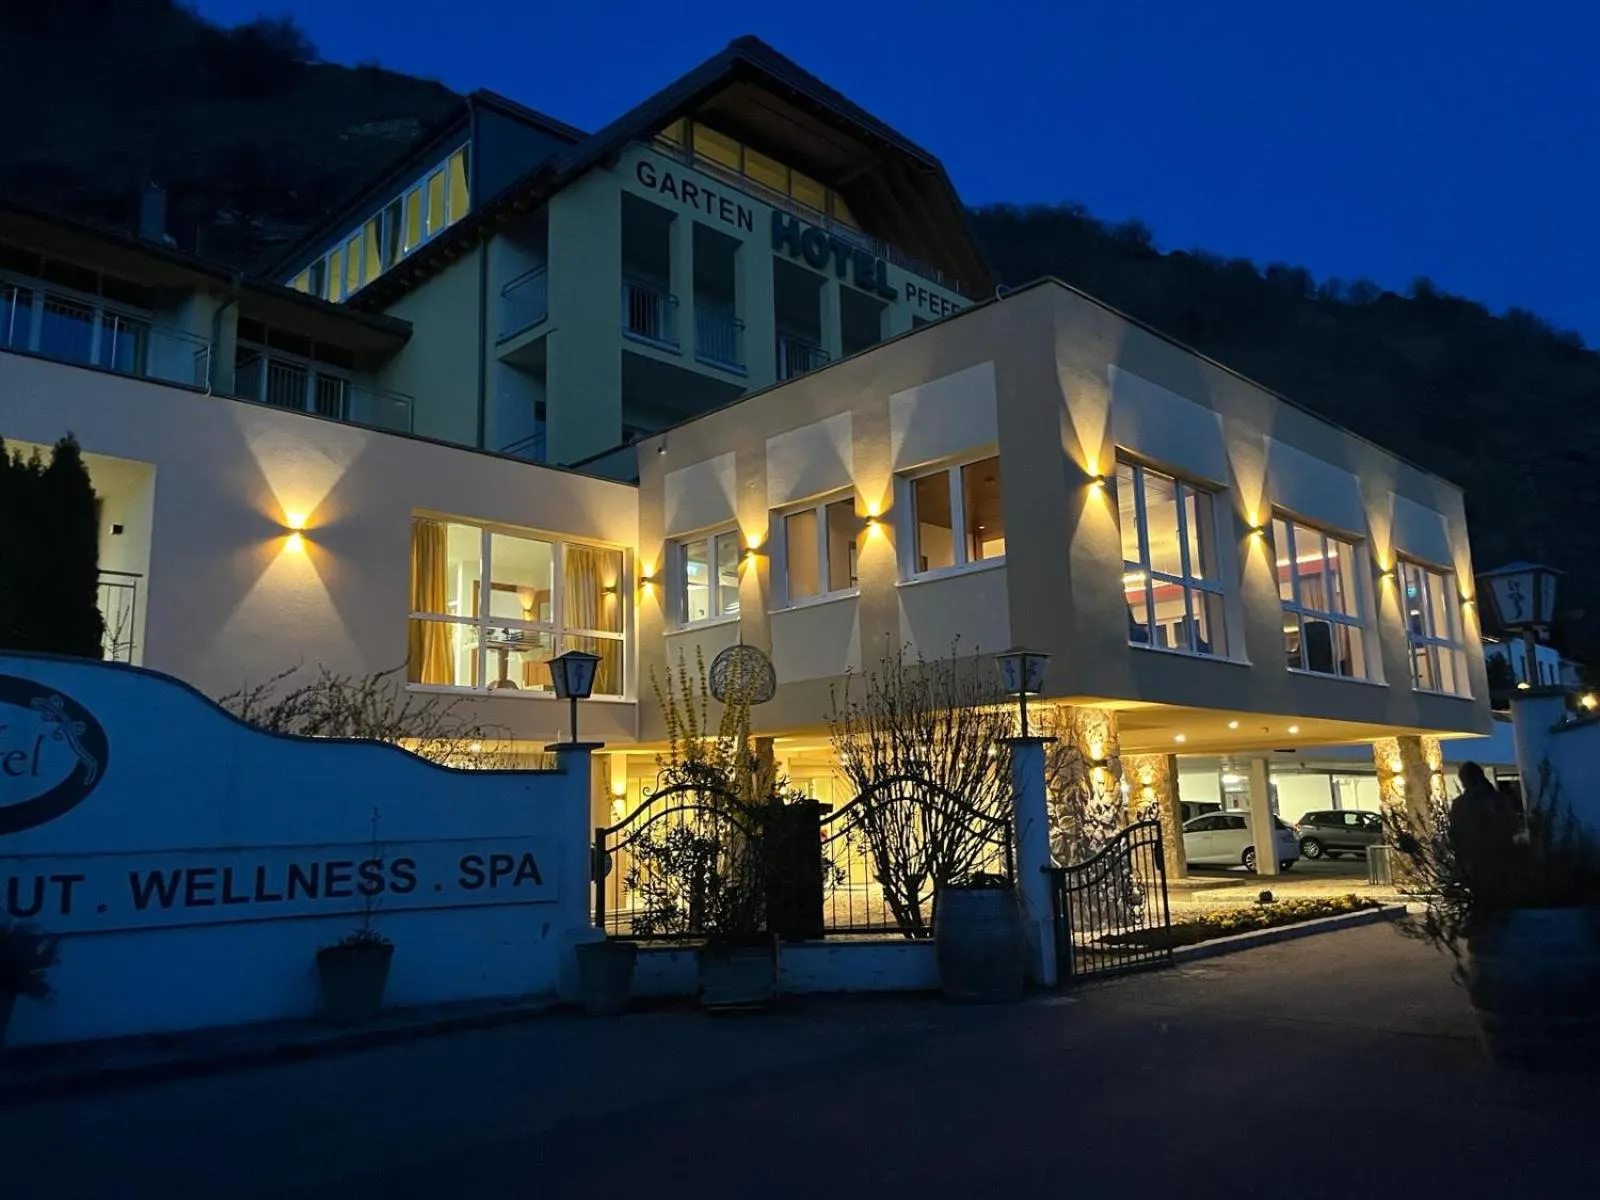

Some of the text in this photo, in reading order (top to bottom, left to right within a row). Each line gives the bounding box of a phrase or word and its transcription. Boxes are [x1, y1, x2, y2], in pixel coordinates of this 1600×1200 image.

[637, 161, 753, 232] GARTEN
[772, 210, 897, 299] HOTEL
[0, 724, 44, 776] el
[8, 873, 86, 917] UT
[130, 858, 417, 911] WELLNESS
[458, 852, 543, 890] SPA
